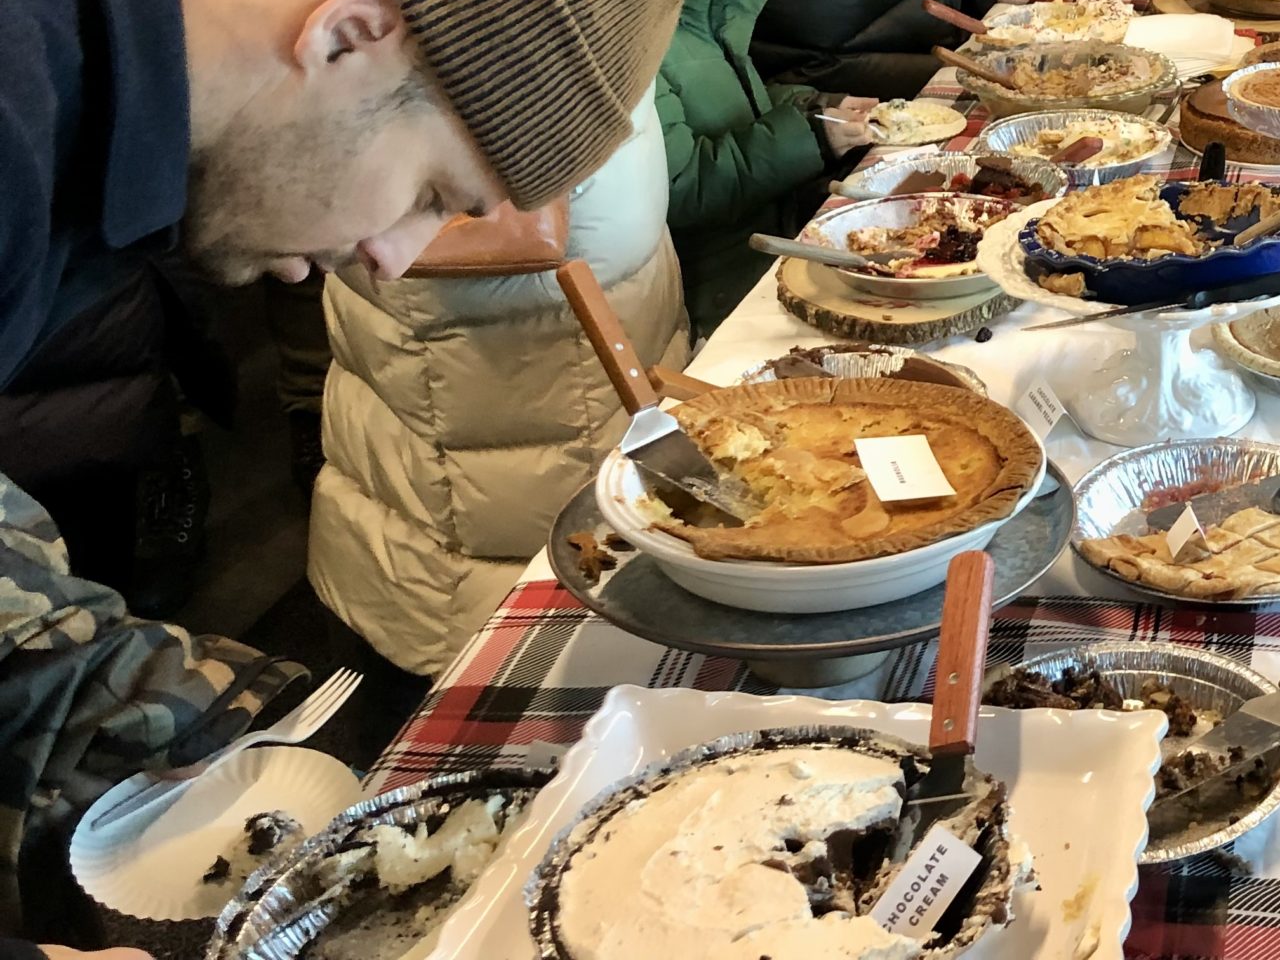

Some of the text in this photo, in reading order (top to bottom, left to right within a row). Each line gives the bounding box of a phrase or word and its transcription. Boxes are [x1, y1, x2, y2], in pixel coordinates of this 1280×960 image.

[1028, 391, 1054, 426] CARAMEL PECAN
[1036, 387, 1056, 414] CHOCOLATE
[882, 844, 949, 933] CHOCOLATE
[908, 873, 949, 927] CREAM
